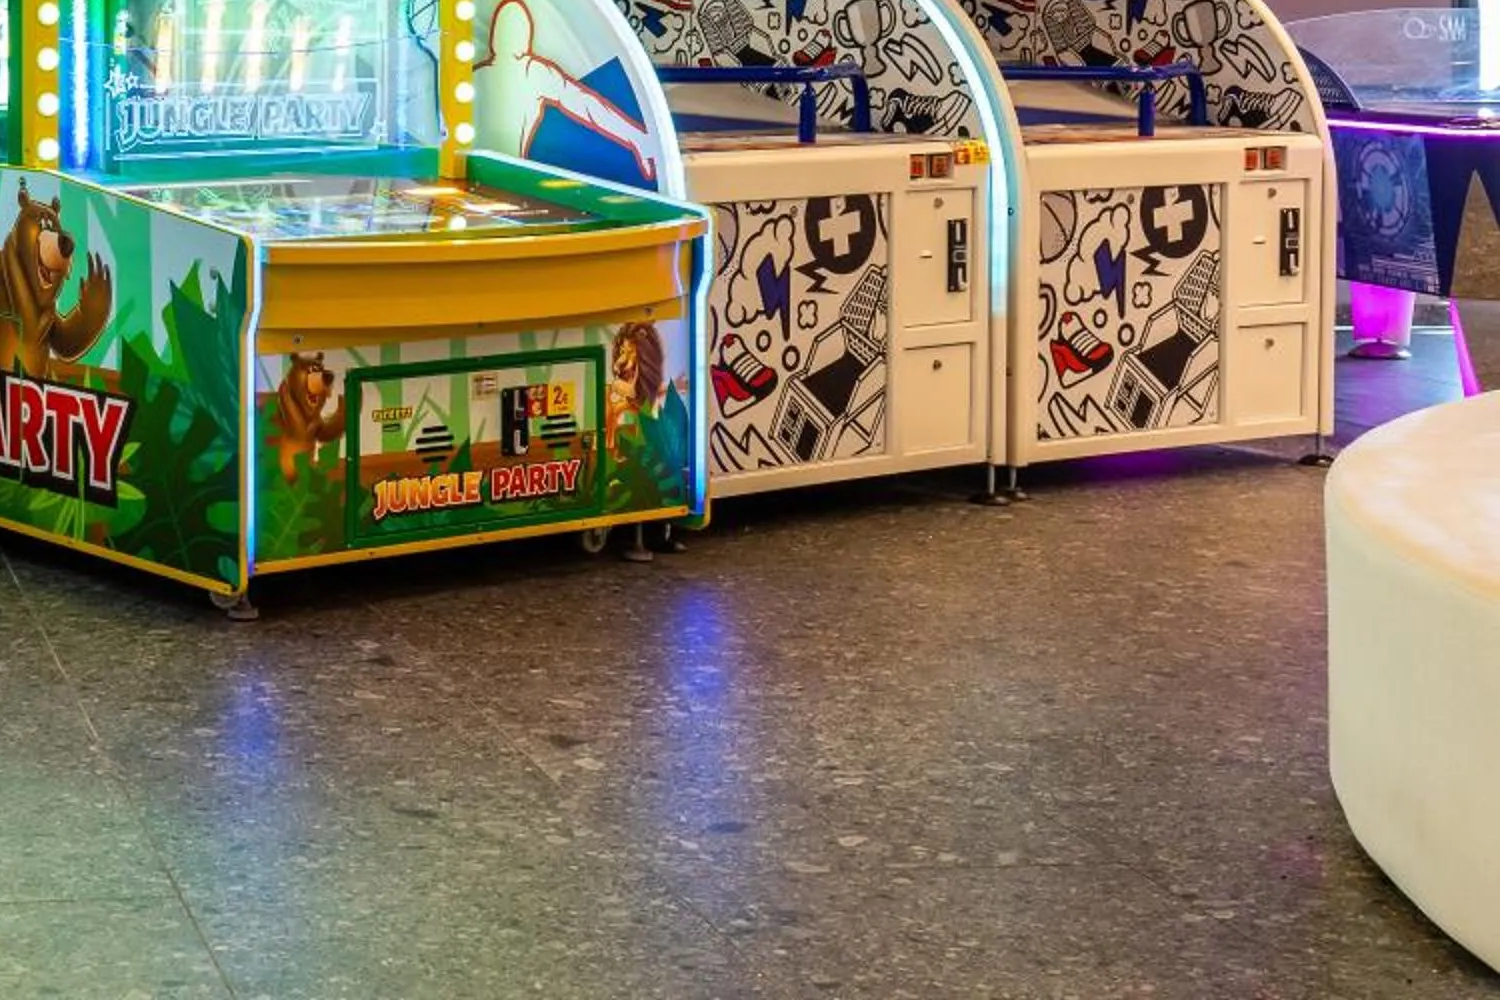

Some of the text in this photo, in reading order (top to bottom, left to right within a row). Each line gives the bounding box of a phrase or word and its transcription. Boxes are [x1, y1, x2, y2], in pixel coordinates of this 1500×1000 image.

[115, 92, 374, 150] JUNGLE PARTY
[373, 459, 581, 521] JUNGLE PARTY
